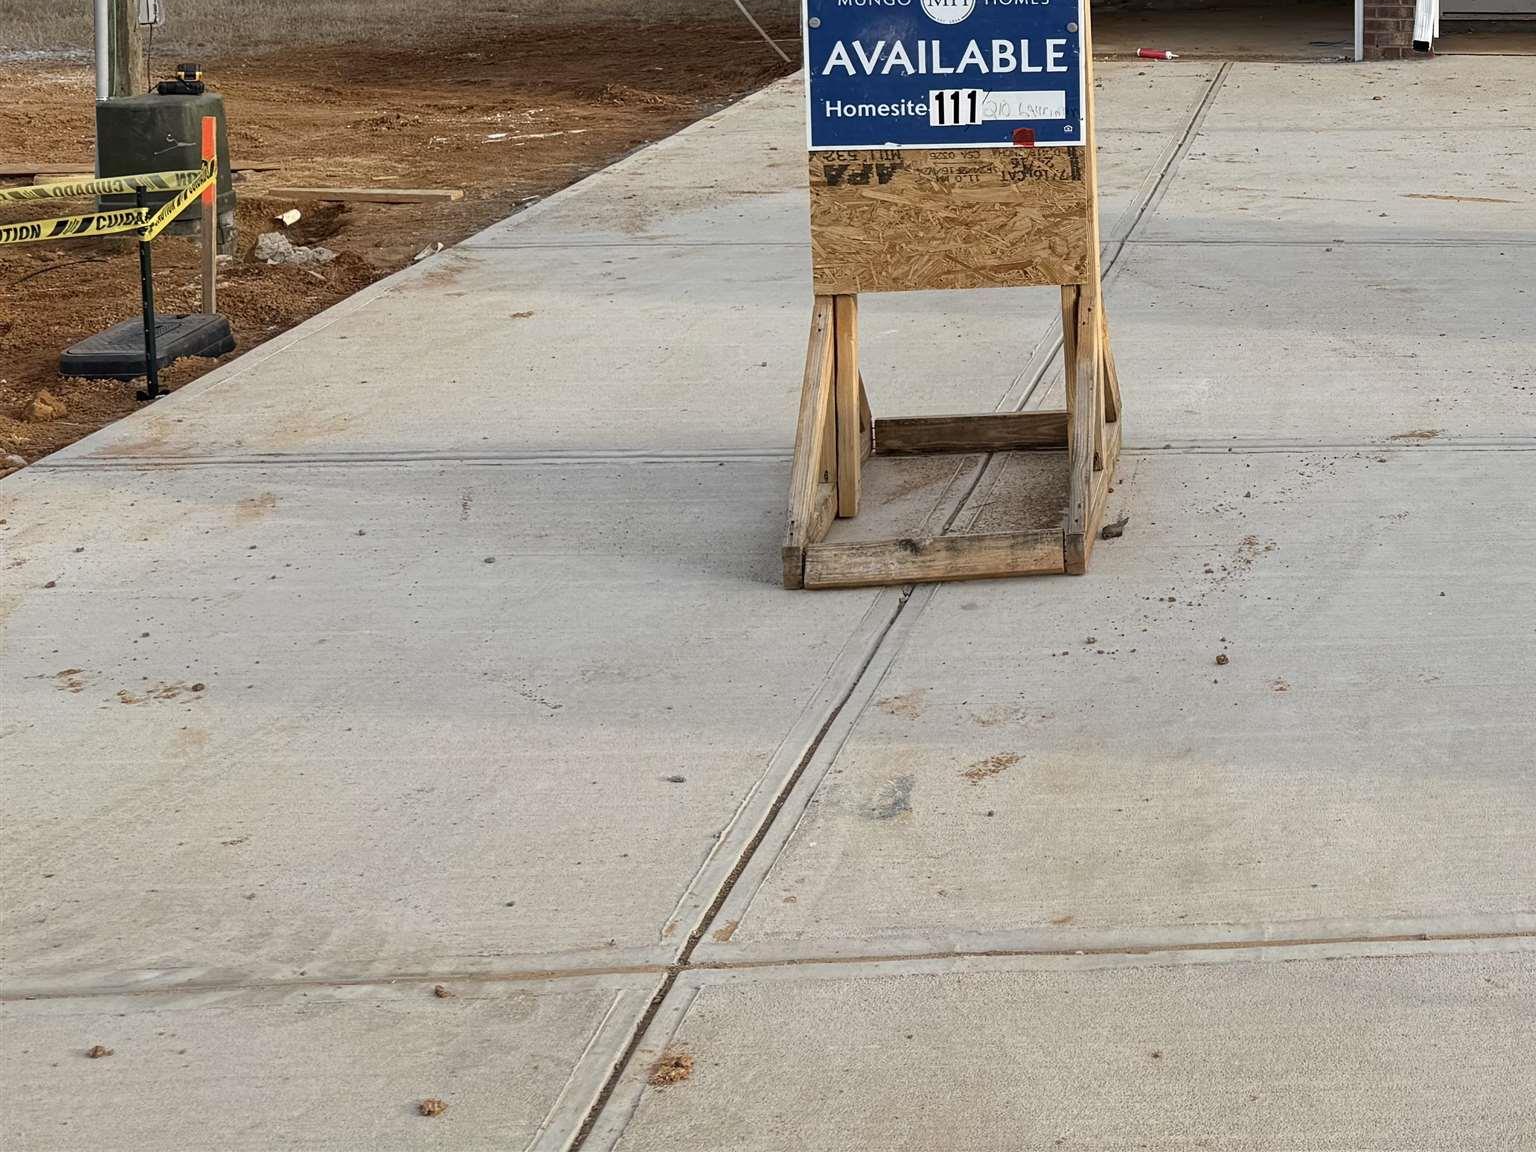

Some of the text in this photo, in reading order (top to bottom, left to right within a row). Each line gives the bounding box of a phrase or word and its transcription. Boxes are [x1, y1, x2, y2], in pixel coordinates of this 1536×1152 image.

[822, 38, 1069, 76] AVAILABLE
[826, 90, 978, 125] Homesite 111
[0, 223, 42, 244] TION
